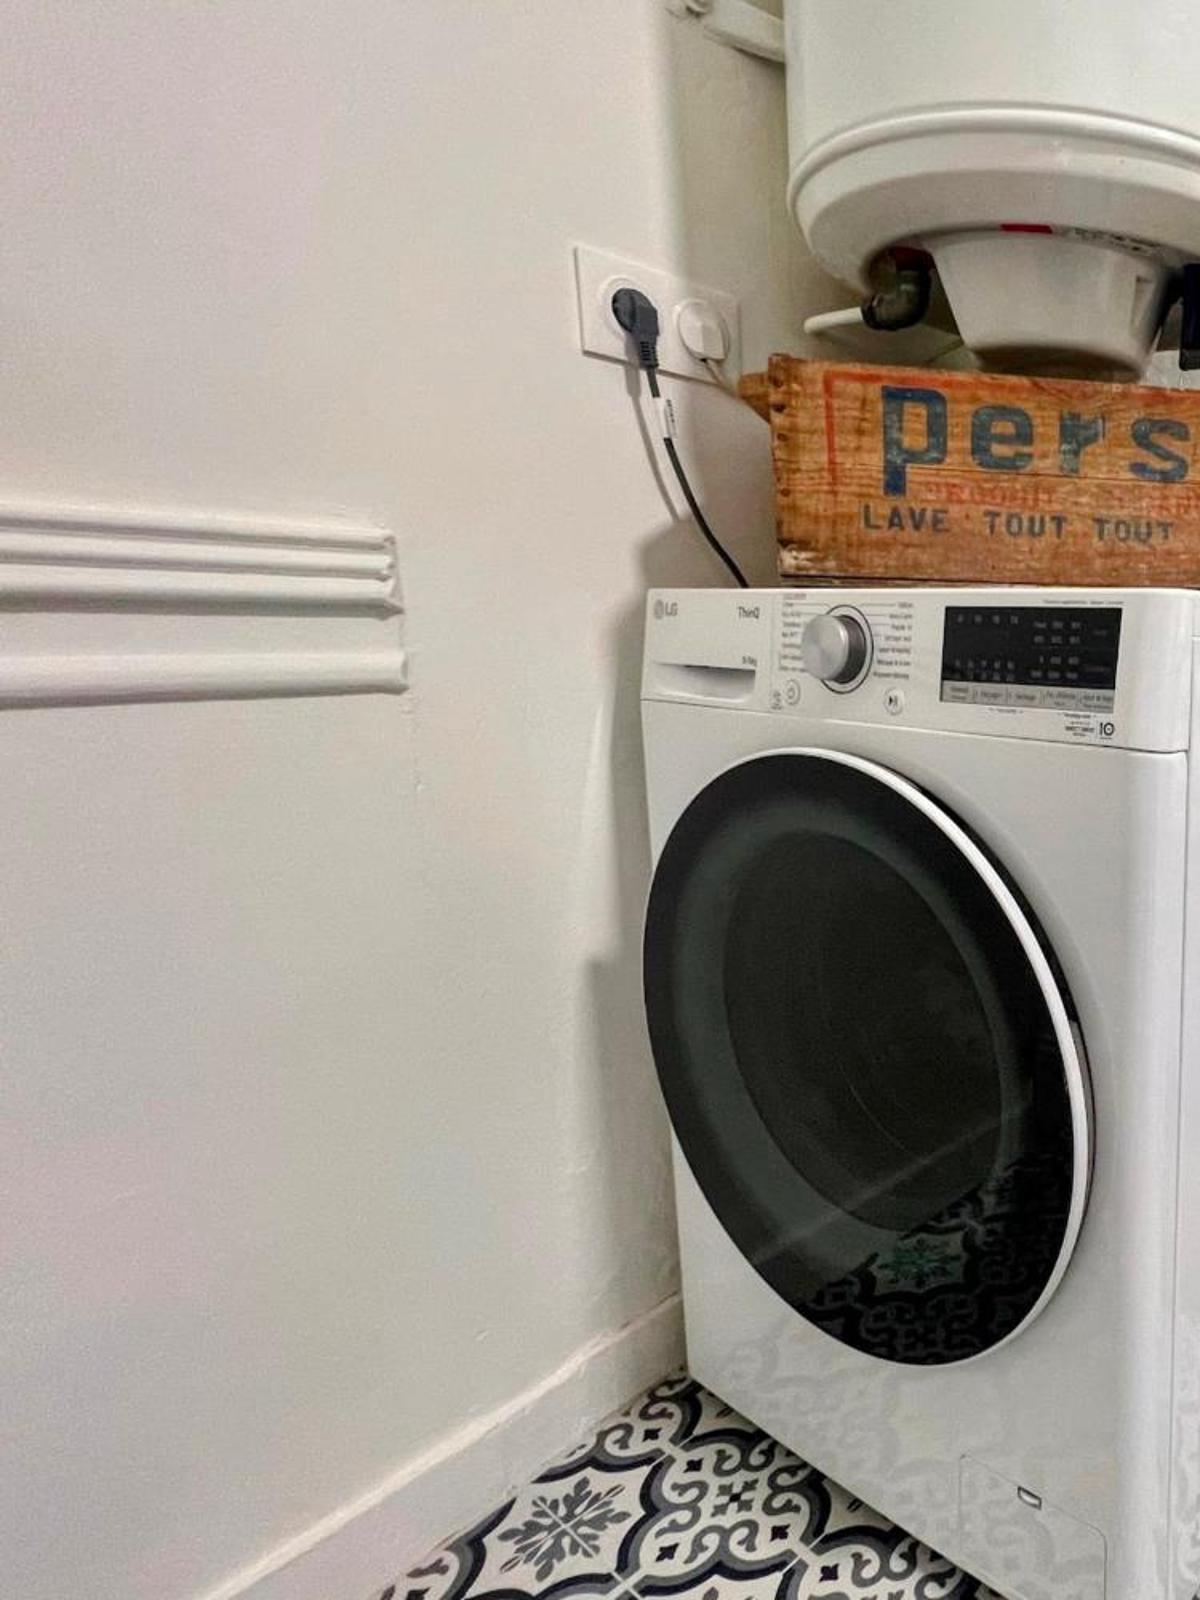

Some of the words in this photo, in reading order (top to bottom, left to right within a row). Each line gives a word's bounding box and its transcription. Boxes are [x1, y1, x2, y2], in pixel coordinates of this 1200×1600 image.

[863, 503, 949, 533] LAVE
[985, 511, 1068, 539] TOUT
[1092, 516, 1175, 543] TOUT
[738, 606, 760, 619] ThinQ
